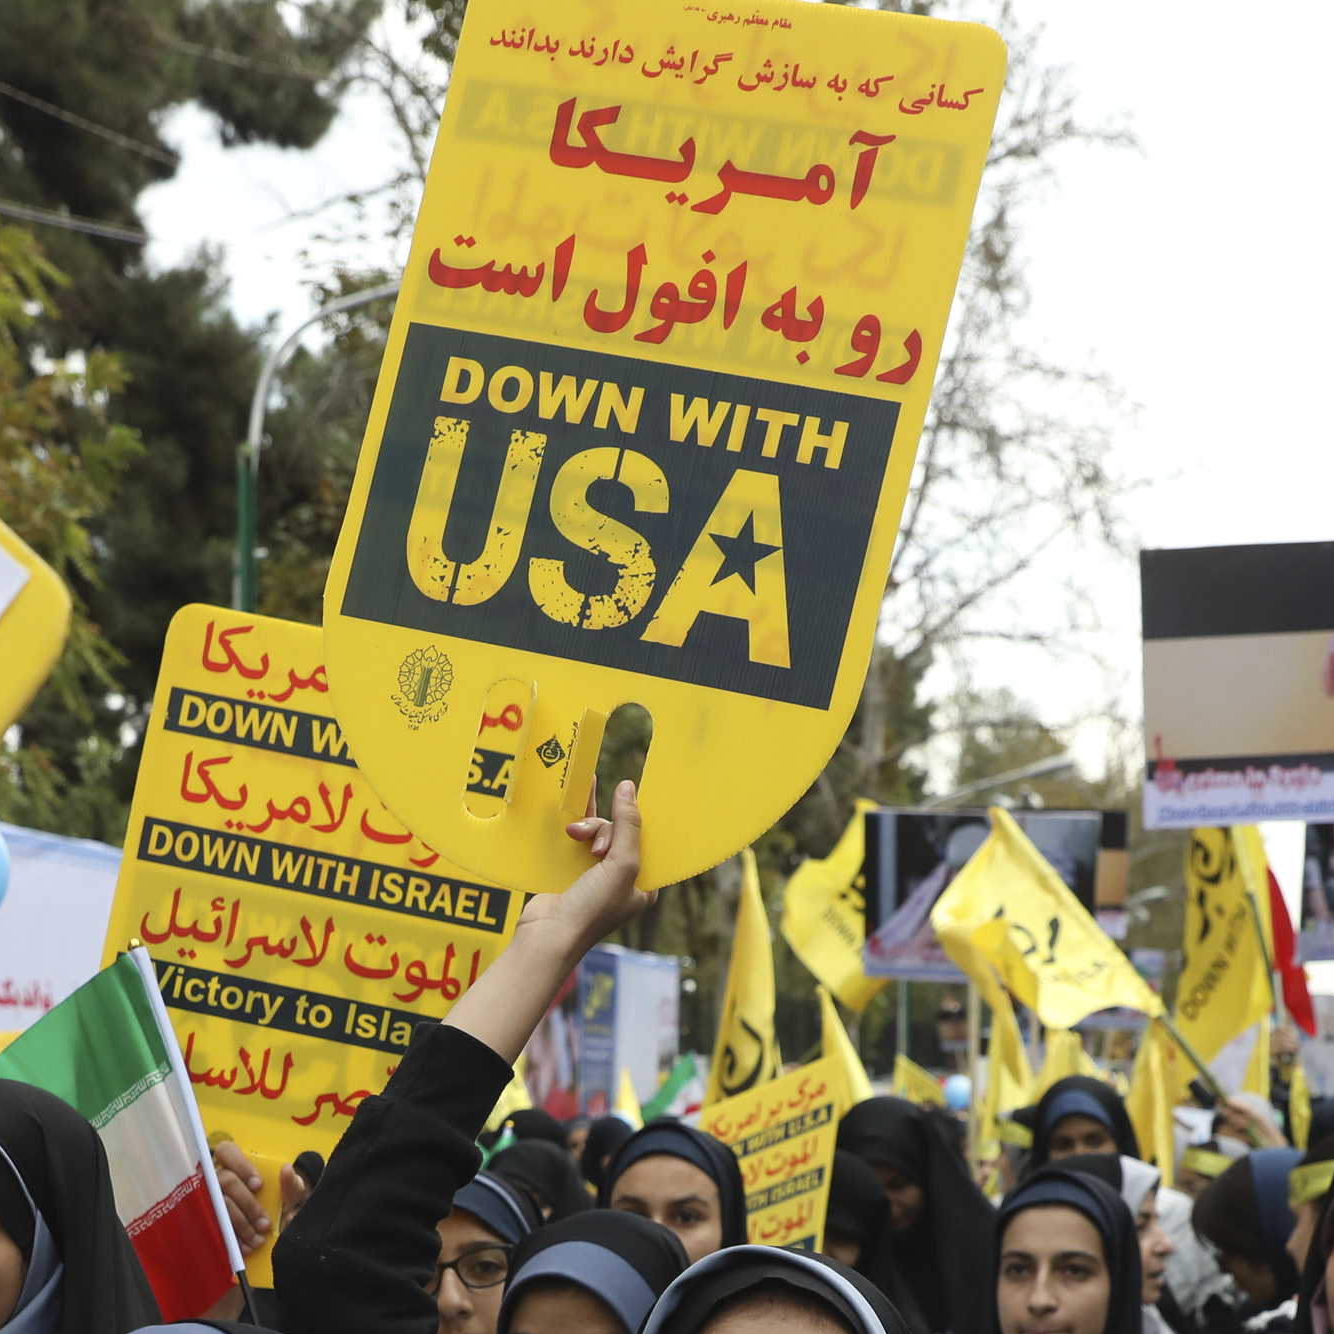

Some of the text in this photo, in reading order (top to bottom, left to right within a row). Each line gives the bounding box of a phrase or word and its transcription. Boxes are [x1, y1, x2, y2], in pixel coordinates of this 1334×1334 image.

[489, 28, 985, 115] کسانی که به سازش گرایش دارند بدانند
[548, 96, 897, 215] آمریکا
[427, 232, 577, 304] است
[582, 243, 749, 345] افول
[760, 285, 826, 365] به
[833, 311, 924, 387] رو
[439, 355, 851, 471] DOWN WITH
[405, 414, 792, 671] USA
[202, 620, 328, 702] مریکا
[177, 693, 299, 750] DOWN
[146, 823, 497, 928] DOWN WITH ISRAEL
[151, 961, 413, 1047] Victory to Isla
